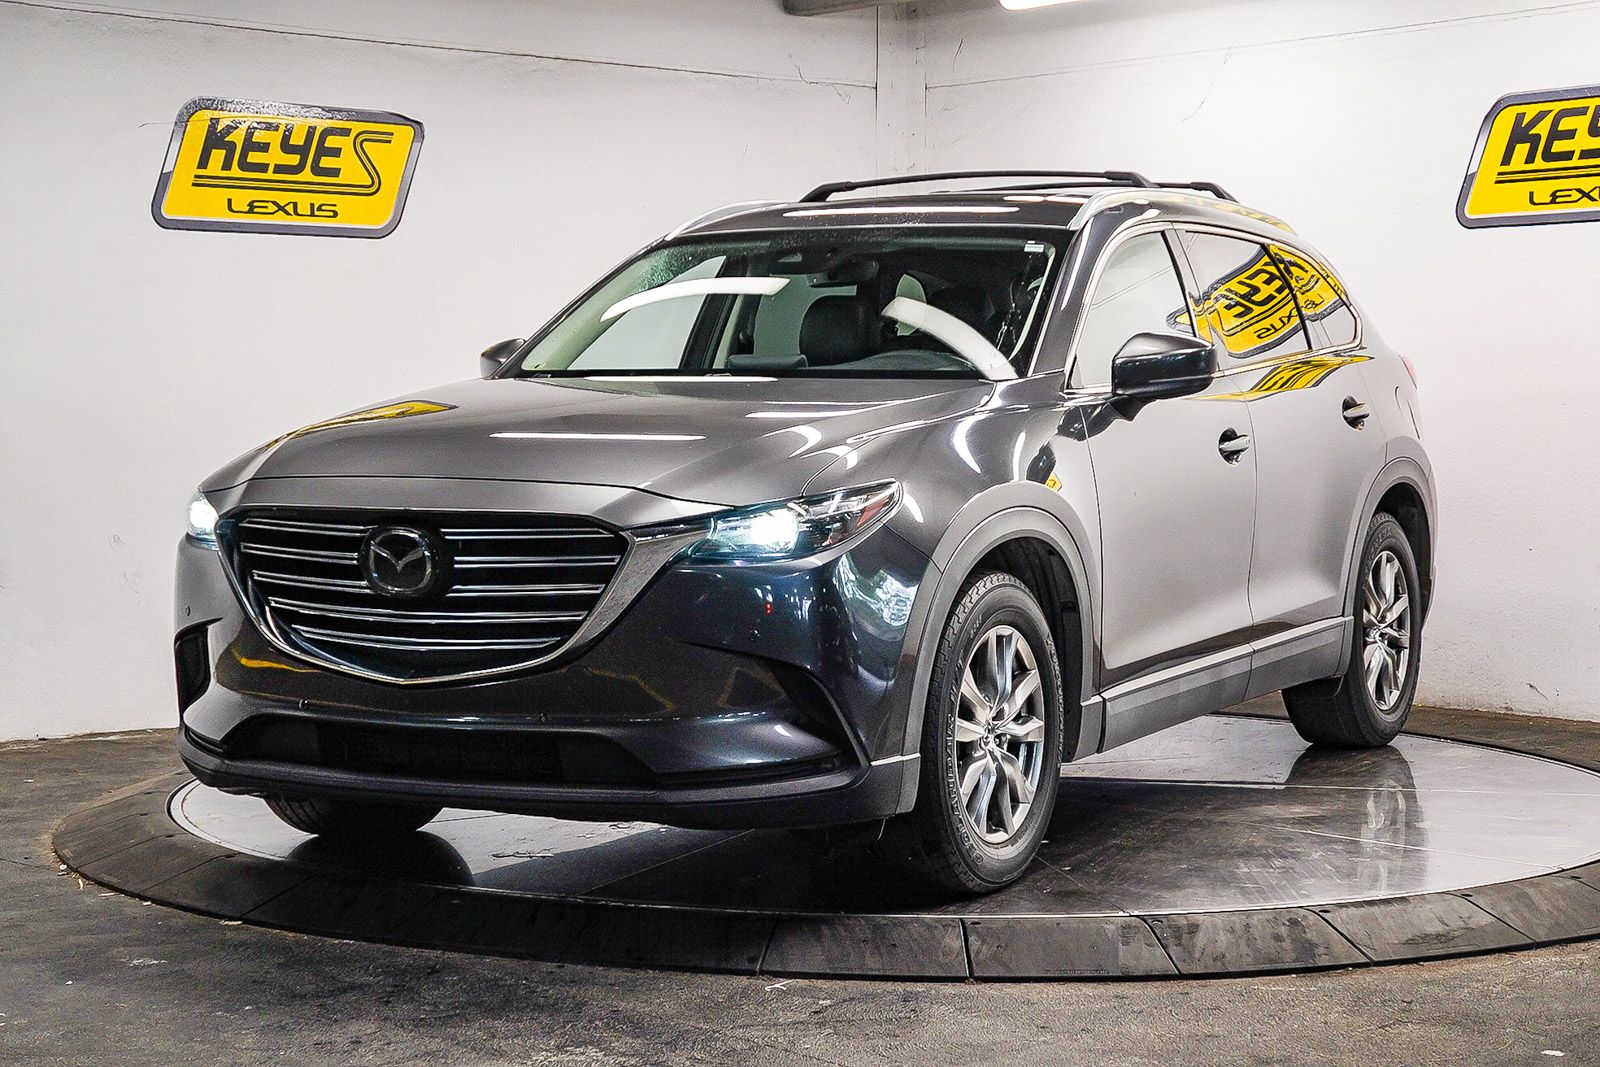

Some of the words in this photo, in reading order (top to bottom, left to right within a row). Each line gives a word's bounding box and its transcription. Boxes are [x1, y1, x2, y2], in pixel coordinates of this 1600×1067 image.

[193, 117, 394, 192] KEYES
[1529, 186, 1600, 206] LEX
[227, 198, 339, 218] LEXUS
